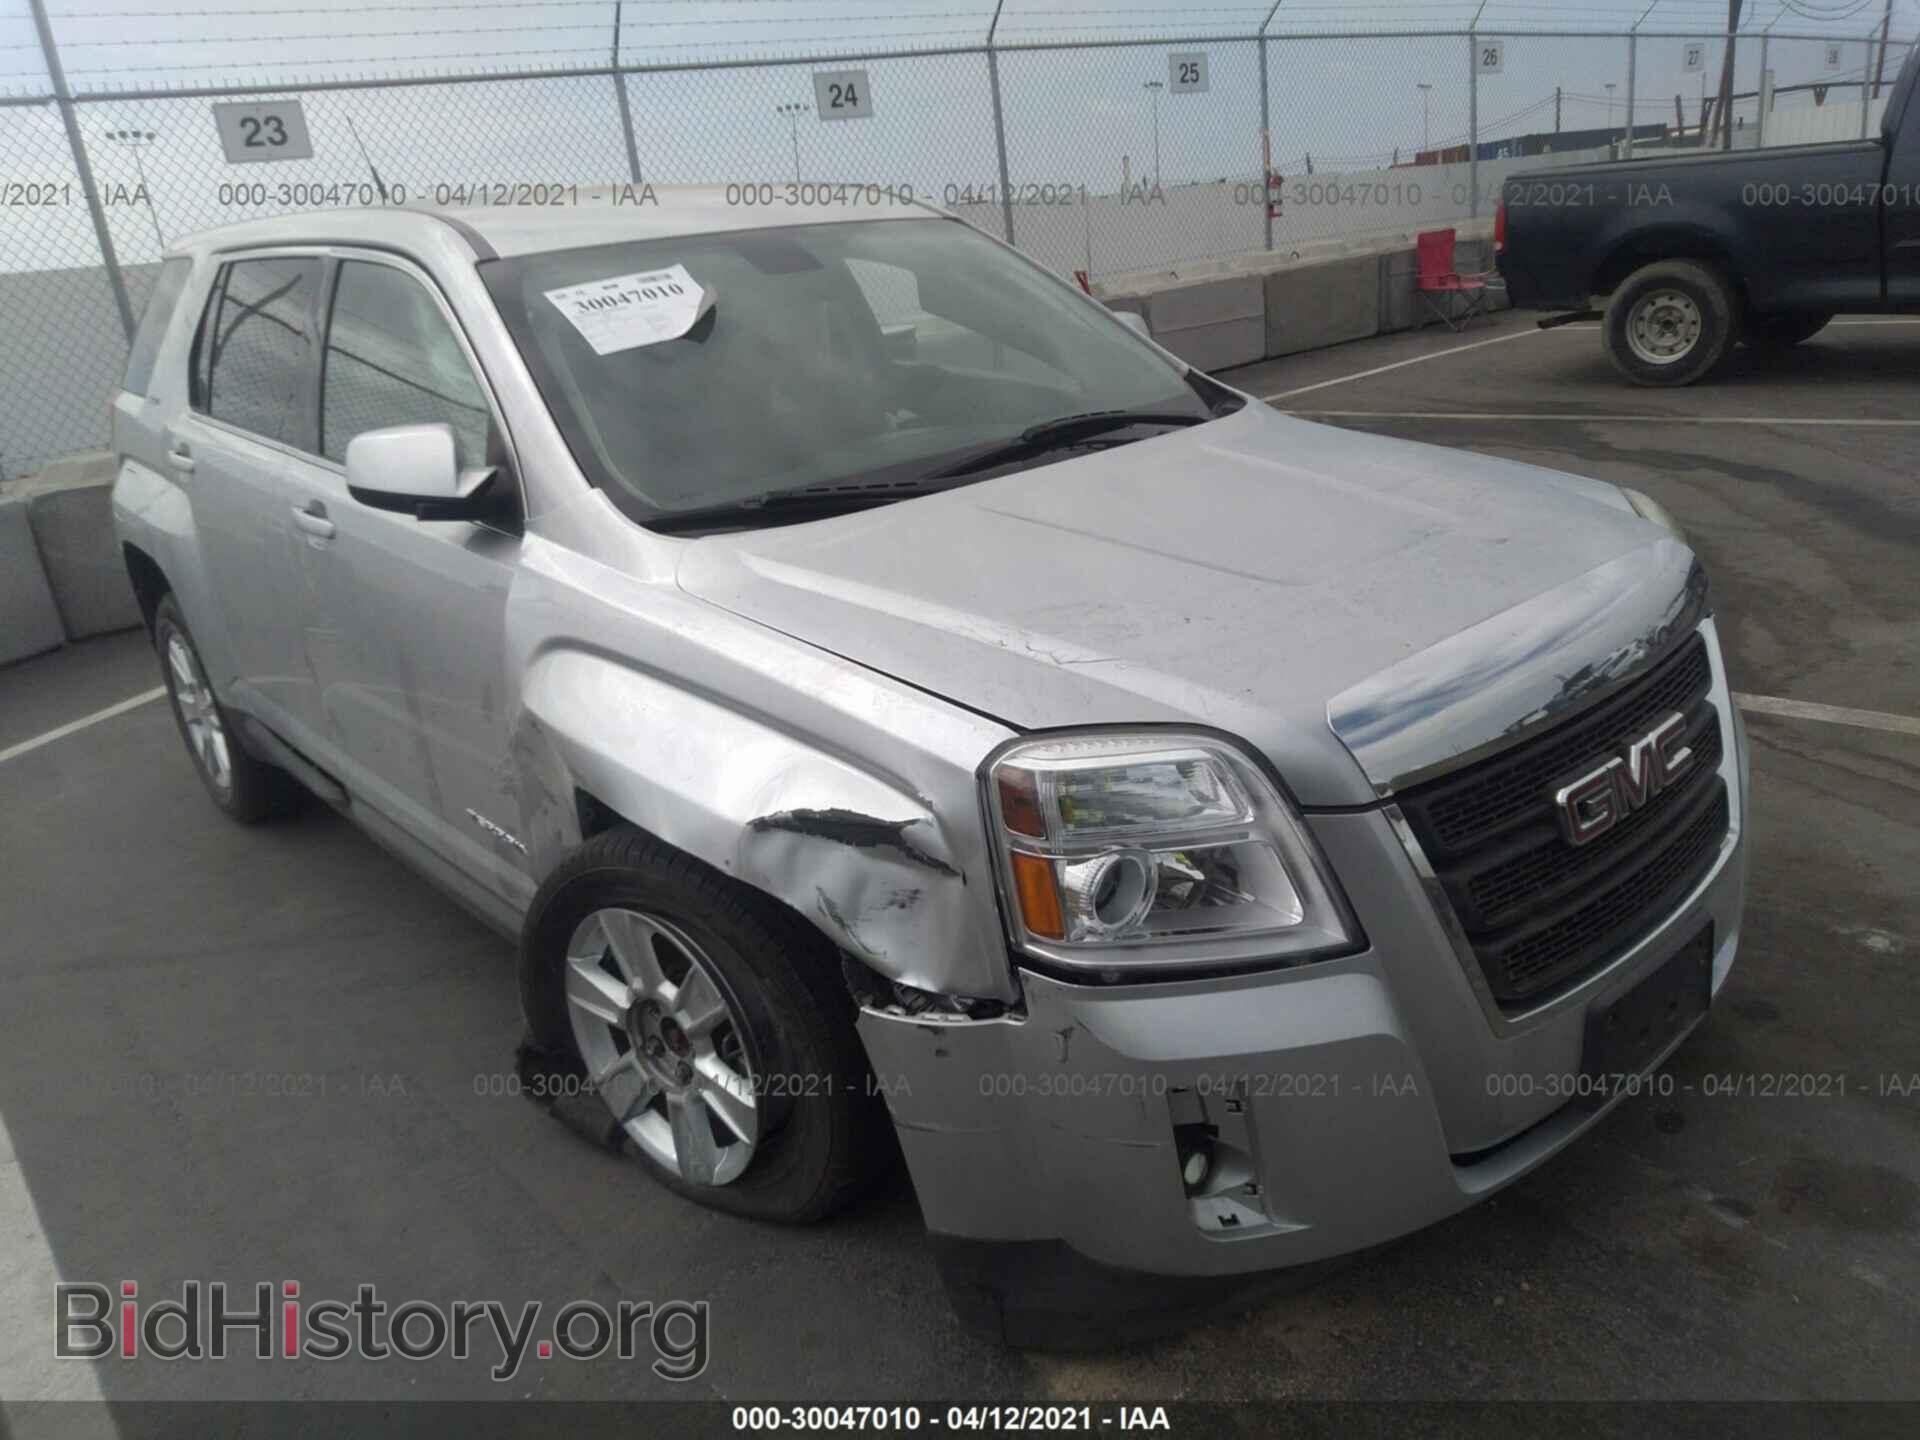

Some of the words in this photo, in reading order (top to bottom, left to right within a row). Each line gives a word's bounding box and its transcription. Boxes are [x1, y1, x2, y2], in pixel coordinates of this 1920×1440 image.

[1482, 48, 1498, 66] 26
[1178, 62, 1201, 84] 25
[828, 83, 859, 109] 24
[240, 116, 288, 147] 23
[574, 283, 685, 314] 30047010
[1555, 711, 1693, 847] GMC
